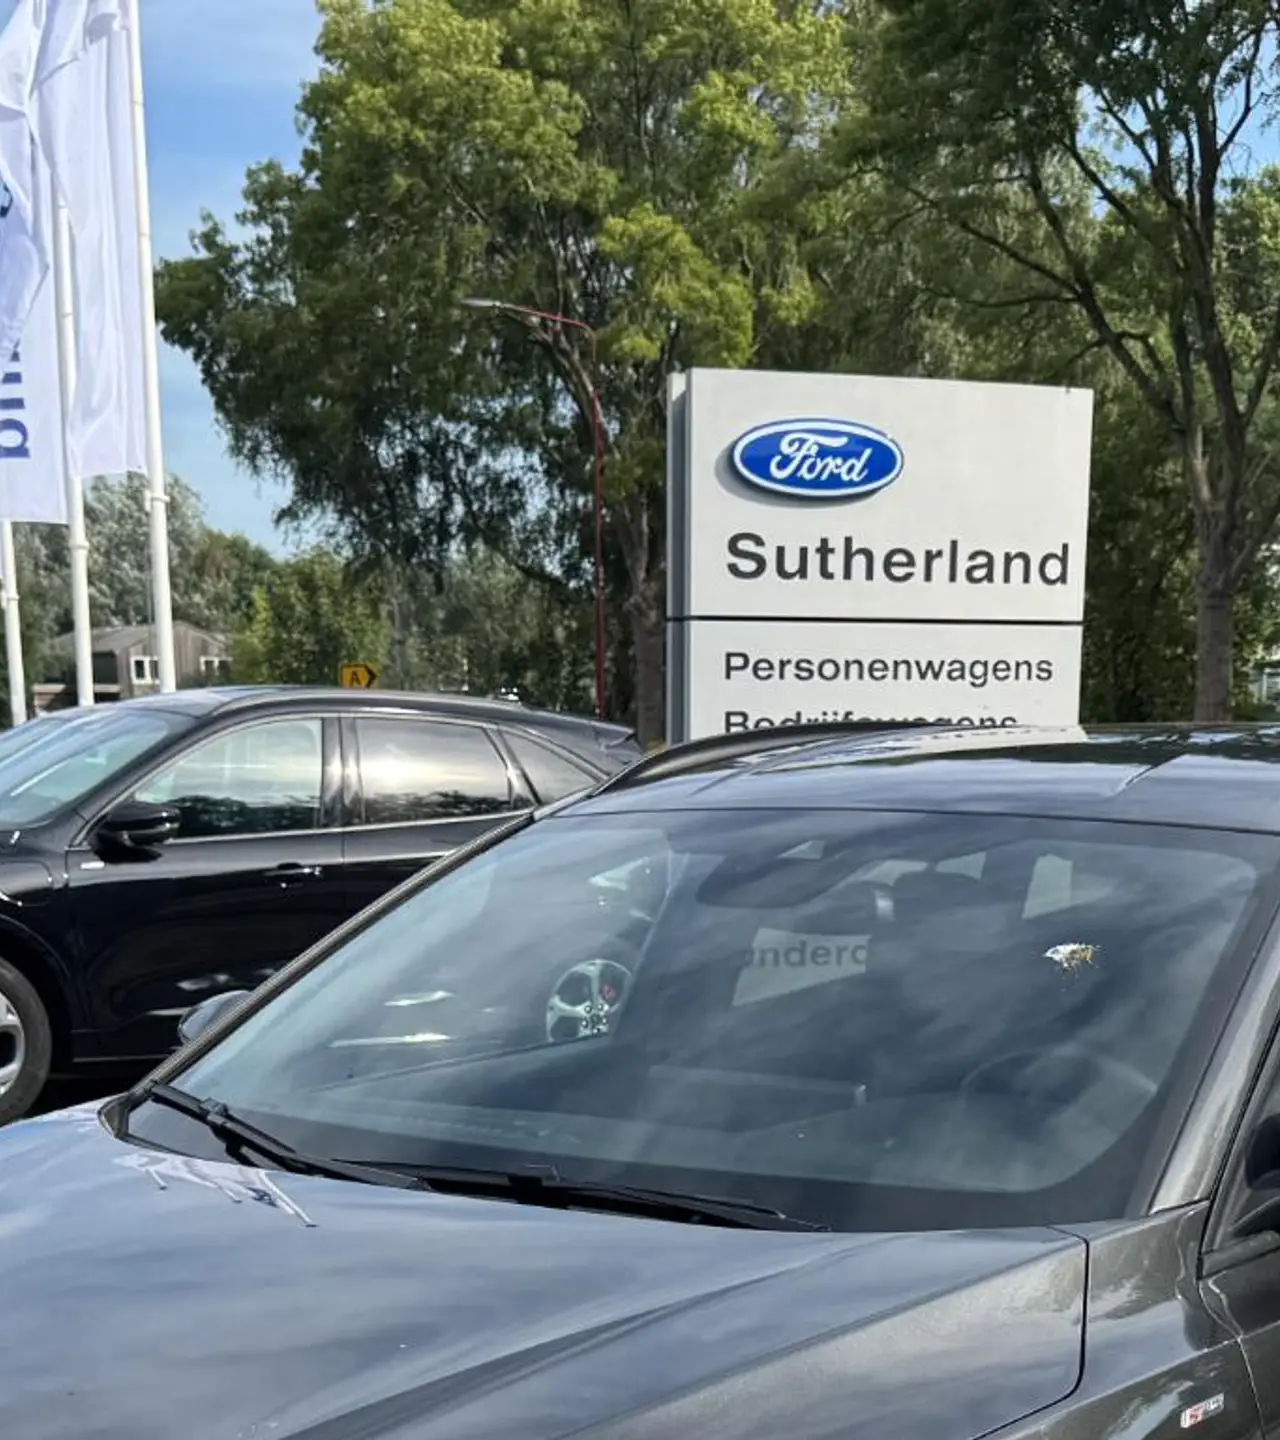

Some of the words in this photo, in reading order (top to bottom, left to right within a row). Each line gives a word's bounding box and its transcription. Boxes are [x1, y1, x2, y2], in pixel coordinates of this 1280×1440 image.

[769, 431, 872, 482] Ford
[726, 532, 1069, 586] Sutherland
[724, 652, 1054, 688] Personenwagens
